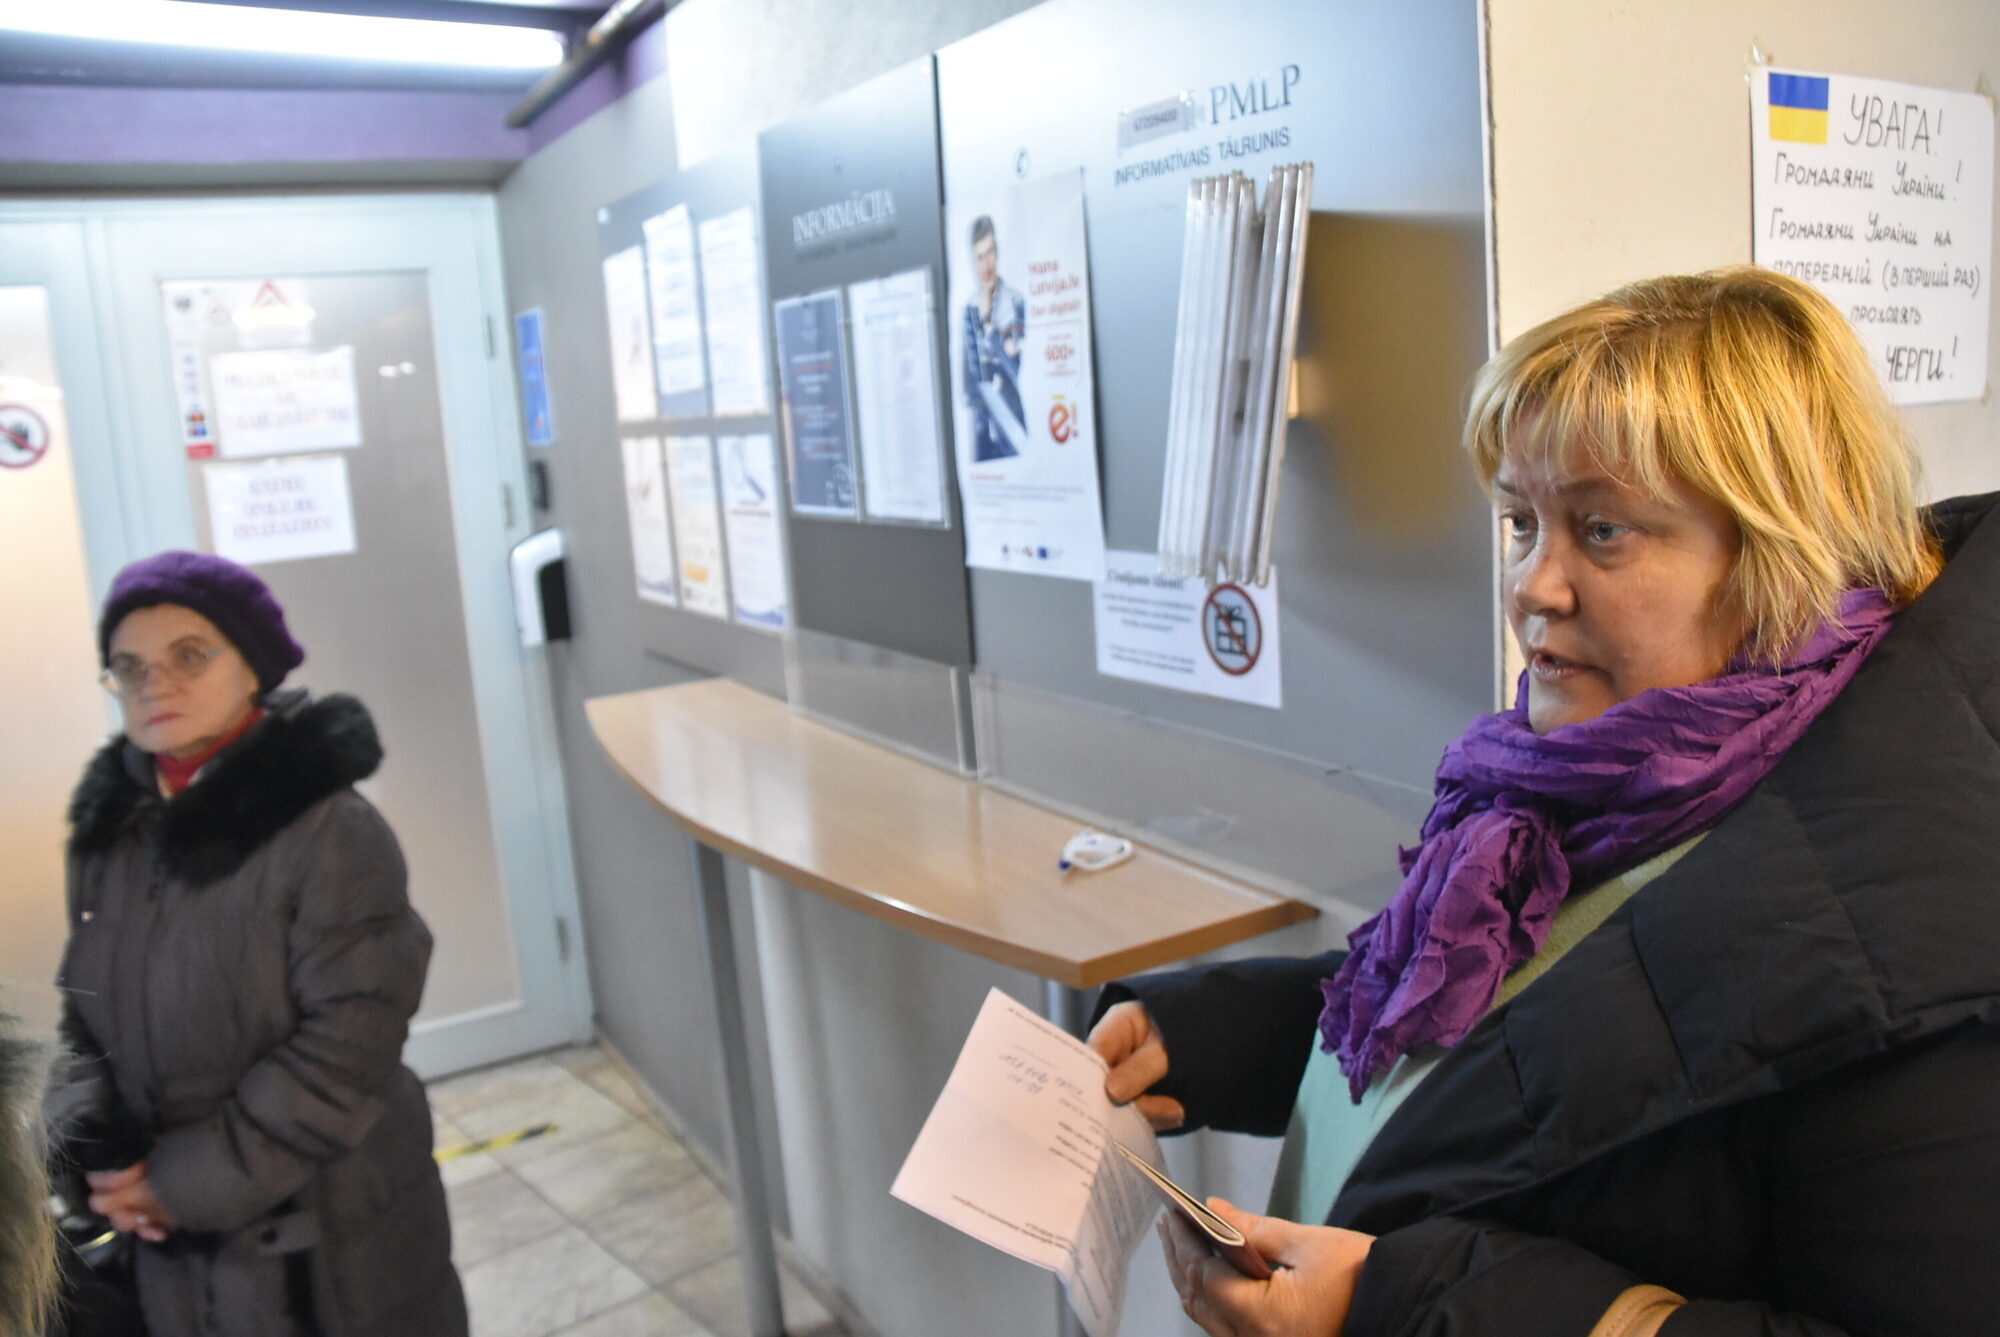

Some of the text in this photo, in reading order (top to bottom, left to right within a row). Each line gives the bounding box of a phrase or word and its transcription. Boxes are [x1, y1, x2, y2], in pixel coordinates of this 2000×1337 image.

[1209, 64, 1301, 125] PMLP
[1843, 93, 1943, 157] УВАГА!
[1886, 335, 1958, 384] ЧЕРГИ!
